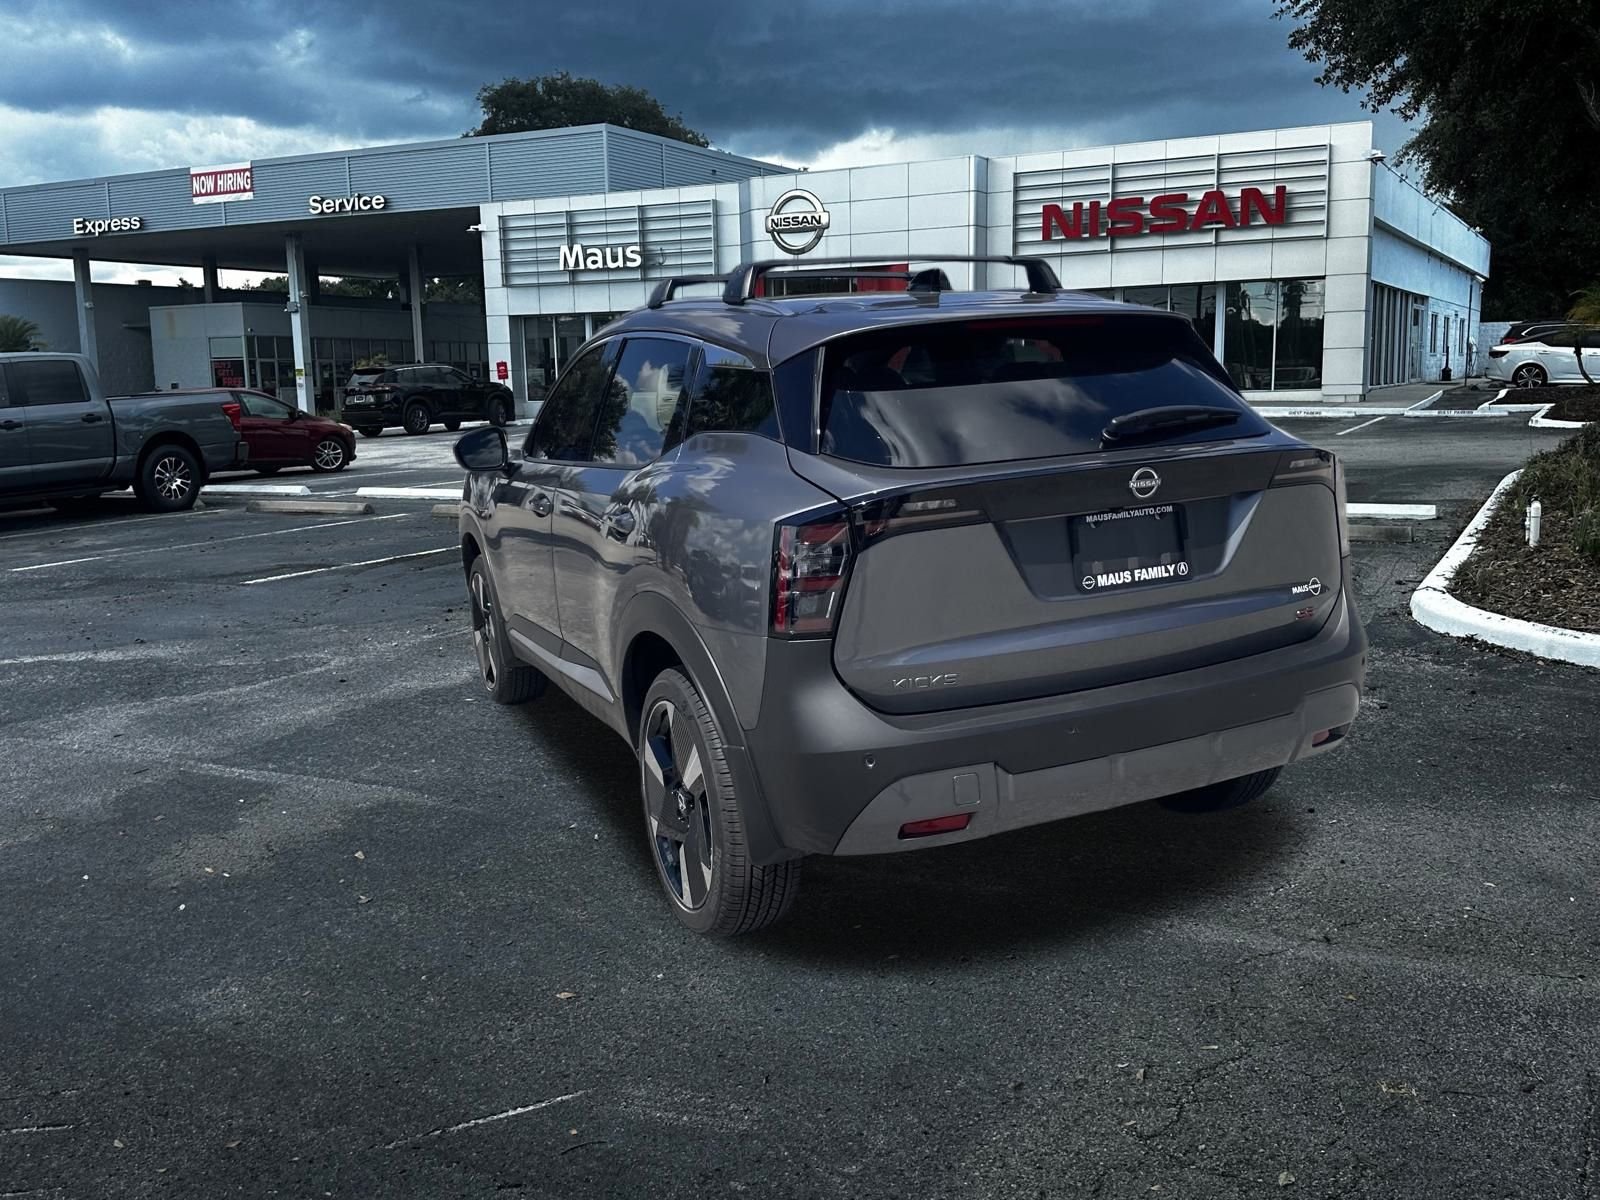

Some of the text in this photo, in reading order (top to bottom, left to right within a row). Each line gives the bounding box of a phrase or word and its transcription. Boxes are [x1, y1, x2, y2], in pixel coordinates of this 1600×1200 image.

[192, 171, 251, 195] NOW HIRING
[308, 193, 385, 215] Service
[1042, 185, 1287, 241] NISSAN
[73, 216, 141, 237] Express
[770, 214, 822, 230] NISSAN
[559, 244, 642, 271] Maus
[1129, 478, 1161, 489] NISSAN
[1086, 505, 1173, 523] MAUSFAMILYAUTO.COM
[1097, 564, 1176, 587] MAUS FAMILY
[1292, 584, 1309, 595] MAUS
[892, 673, 958, 688] KICKS
